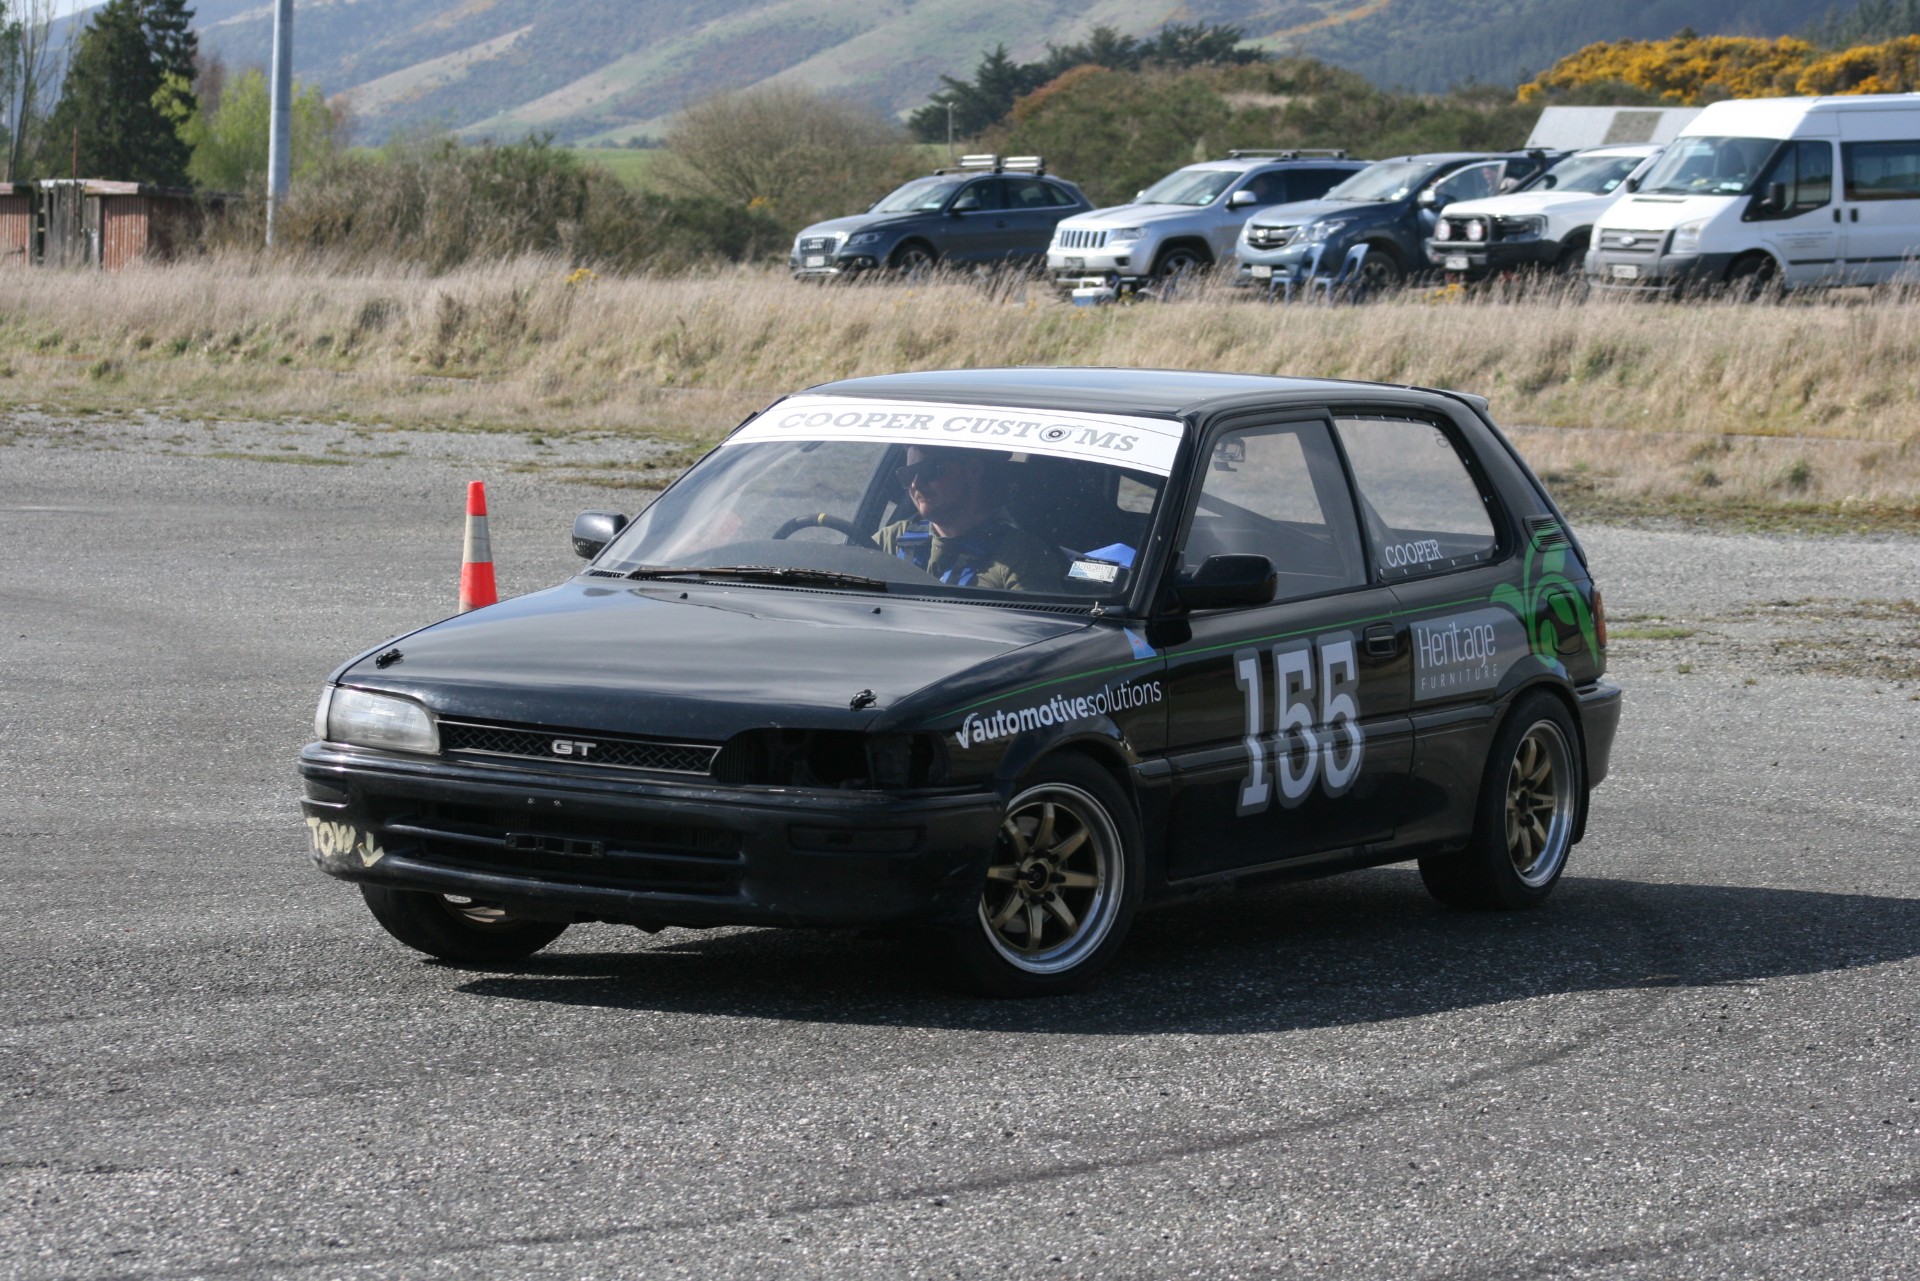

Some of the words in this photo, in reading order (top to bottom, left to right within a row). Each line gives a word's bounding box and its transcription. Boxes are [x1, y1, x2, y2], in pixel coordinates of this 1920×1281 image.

[778, 412, 935, 430] COOPER
[1384, 539, 1443, 567] COOPER
[1417, 621, 1496, 668] Heritage
[1421, 663, 1498, 690] FURNITURE
[972, 680, 1162, 742] automotivesolutions
[551, 739, 597, 756] GT
[306, 817, 356, 857] TOW
